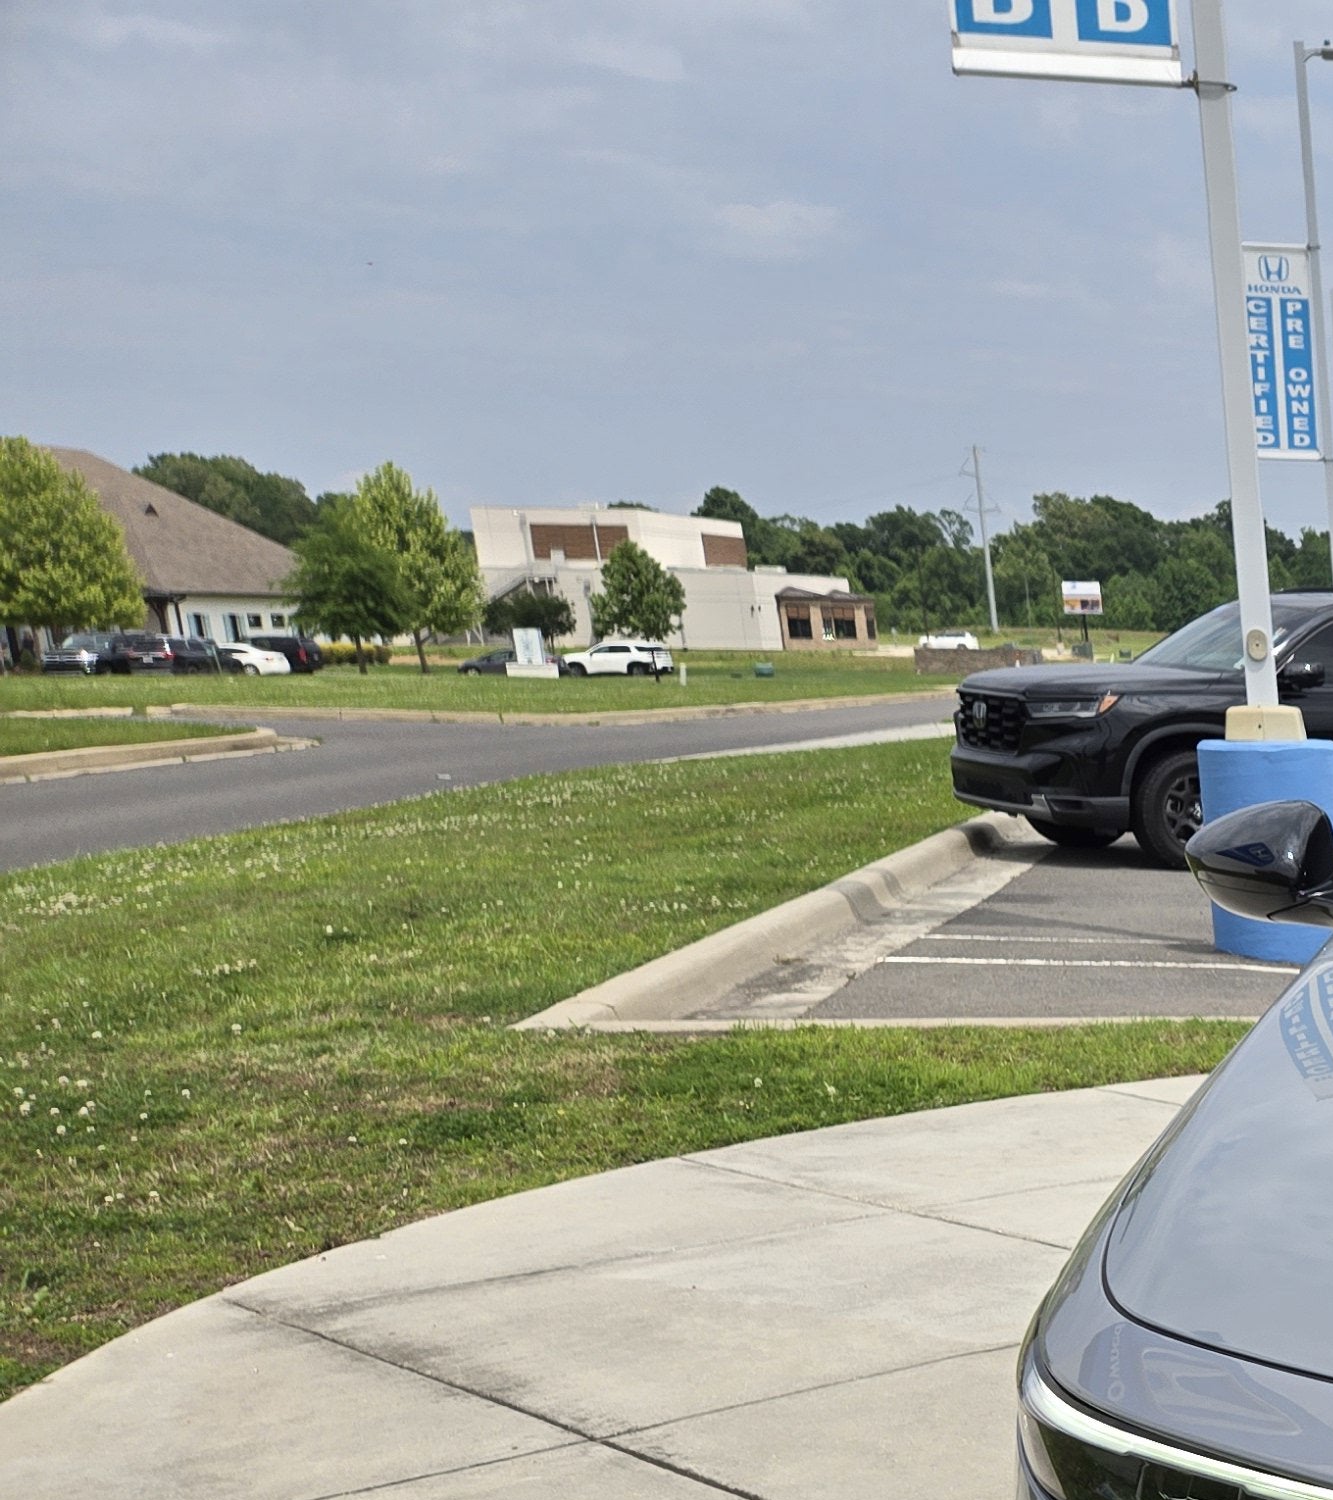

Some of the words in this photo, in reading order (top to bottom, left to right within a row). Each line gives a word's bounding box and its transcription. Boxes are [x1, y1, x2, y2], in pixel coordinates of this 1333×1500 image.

[1248, 284, 1302, 295] HONDA
[1287, 301, 1305, 349] PRE
[1247, 300, 1275, 446] CERTIFIED
[1287, 367, 1311, 447] OWNED
